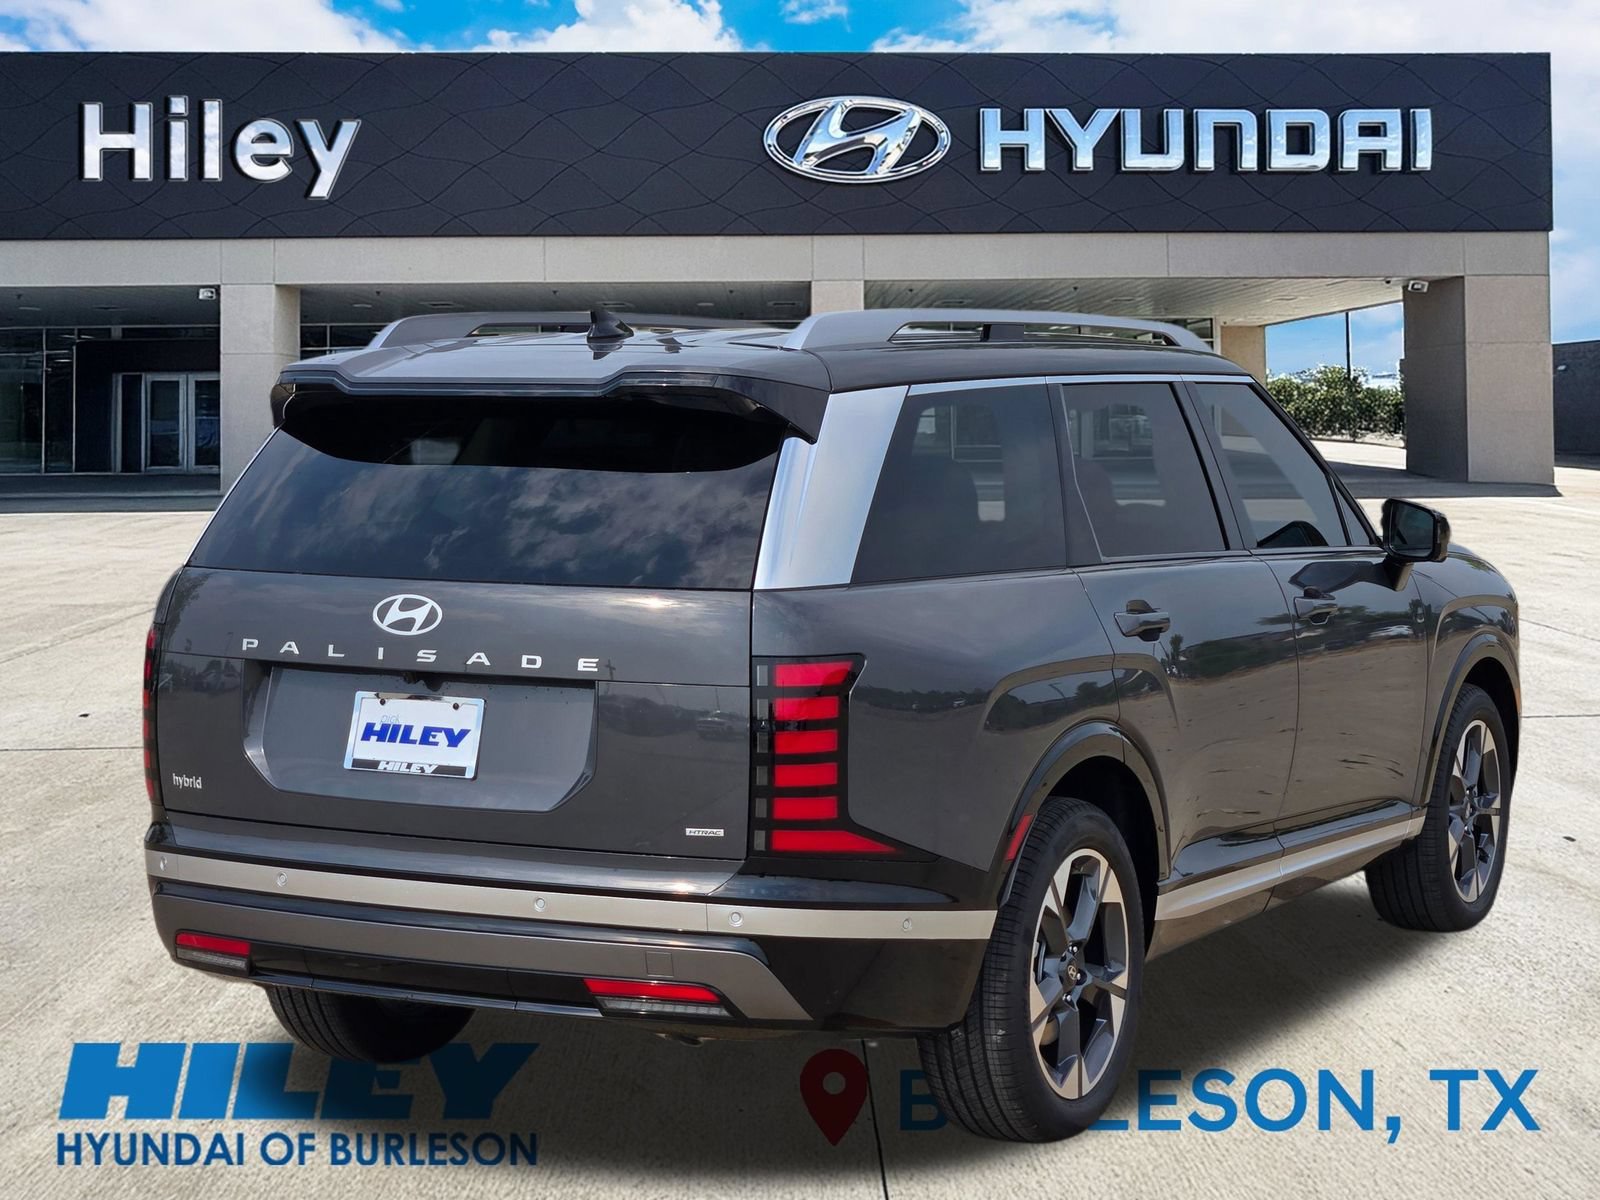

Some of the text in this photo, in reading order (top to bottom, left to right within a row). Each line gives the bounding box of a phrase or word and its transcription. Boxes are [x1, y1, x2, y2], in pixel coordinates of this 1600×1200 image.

[81, 95, 361, 200] Hiley
[979, 107, 1433, 173] HYUNDAI
[241, 637, 601, 673] PALISADE
[360, 722, 471, 748] HILEY
[172, 773, 202, 789] hybrid
[377, 760, 438, 774] HILEY
